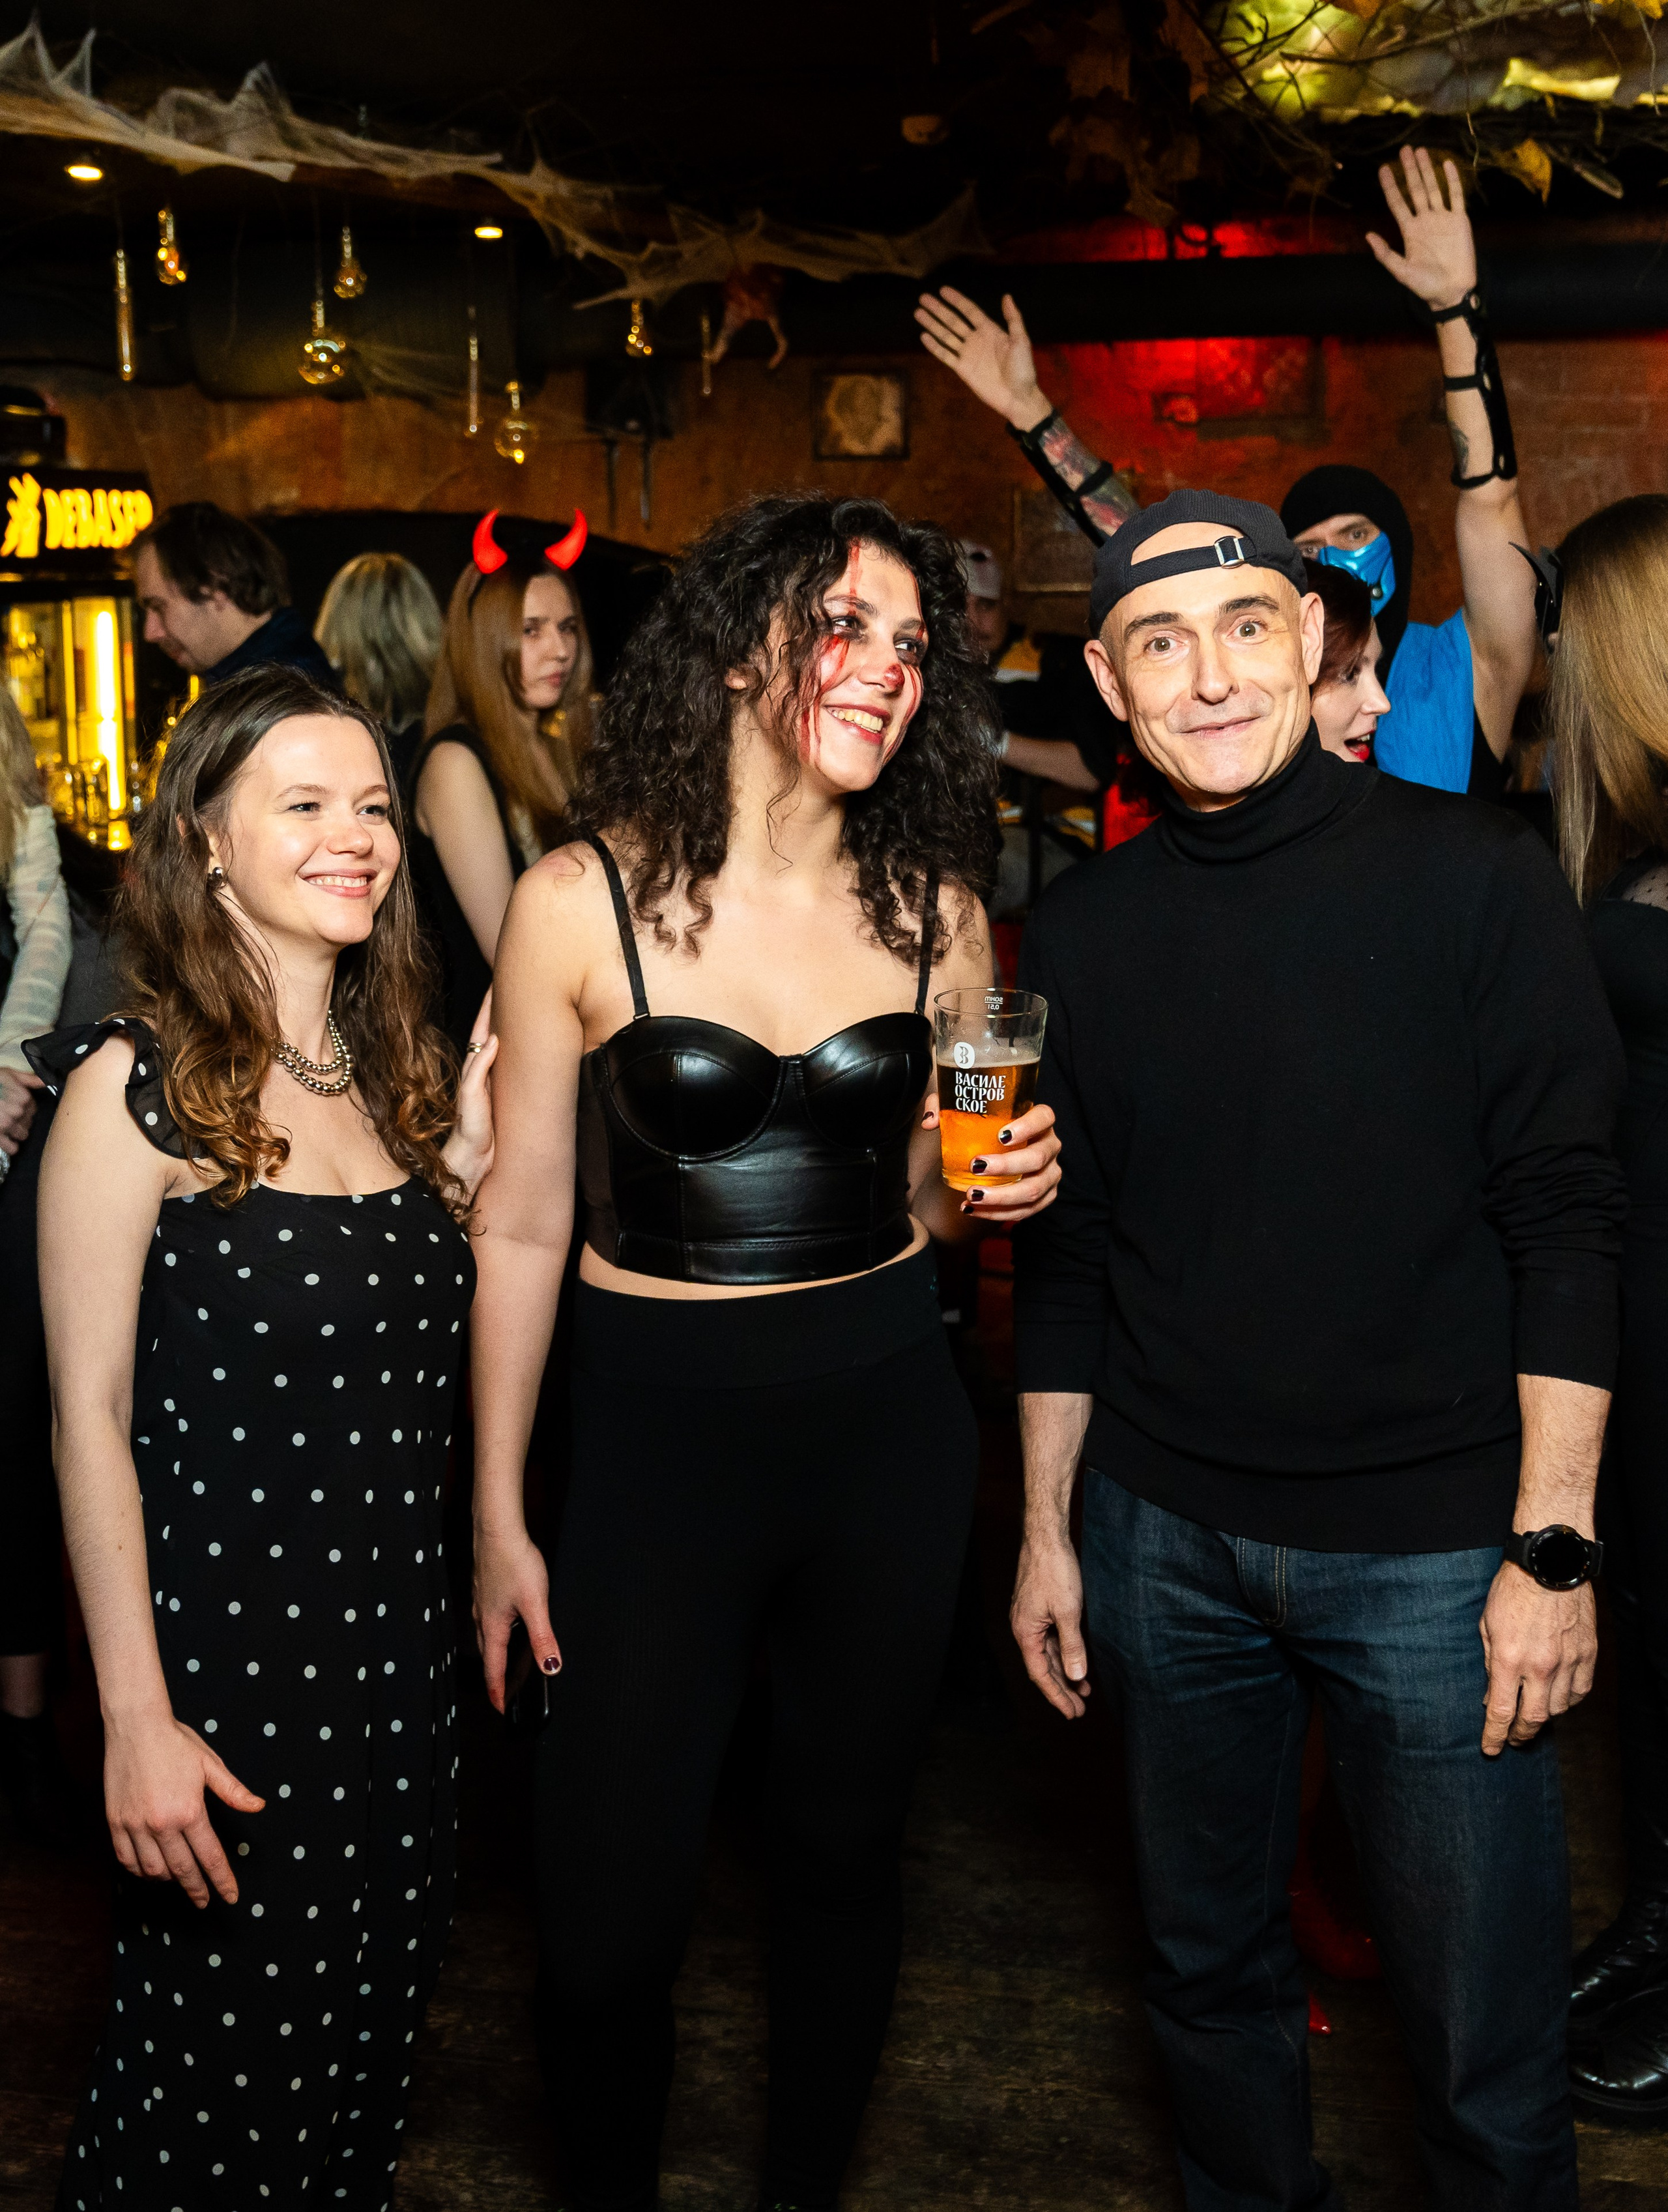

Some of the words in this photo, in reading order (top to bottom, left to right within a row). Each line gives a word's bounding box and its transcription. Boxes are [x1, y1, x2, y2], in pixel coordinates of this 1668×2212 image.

[955, 1071, 1007, 1088] ВАСИЛЕ
[955, 1084, 1005, 1101] ОСТРОВ
[955, 1097, 988, 1114] СКОЕ
